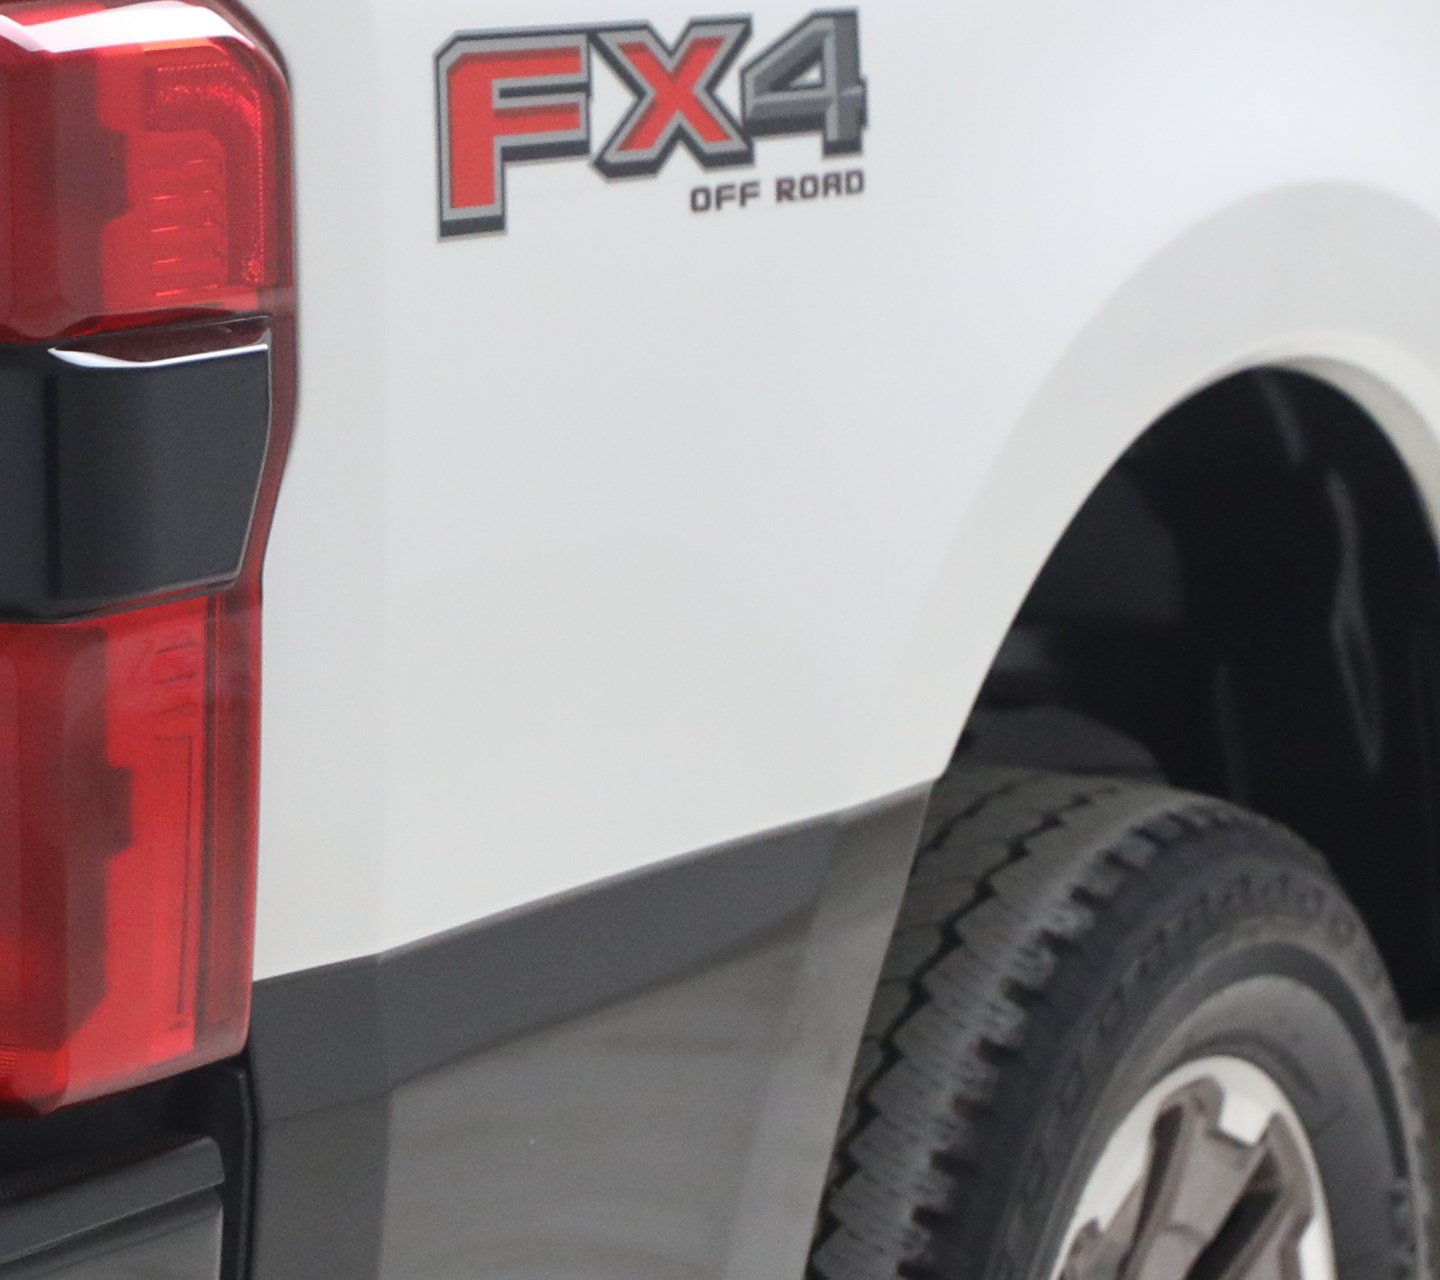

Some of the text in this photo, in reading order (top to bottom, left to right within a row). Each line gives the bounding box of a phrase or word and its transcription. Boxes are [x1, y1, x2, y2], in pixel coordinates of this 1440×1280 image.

[433, 7, 868, 243] FX4
[690, 169, 866, 213] OFF ROAD
